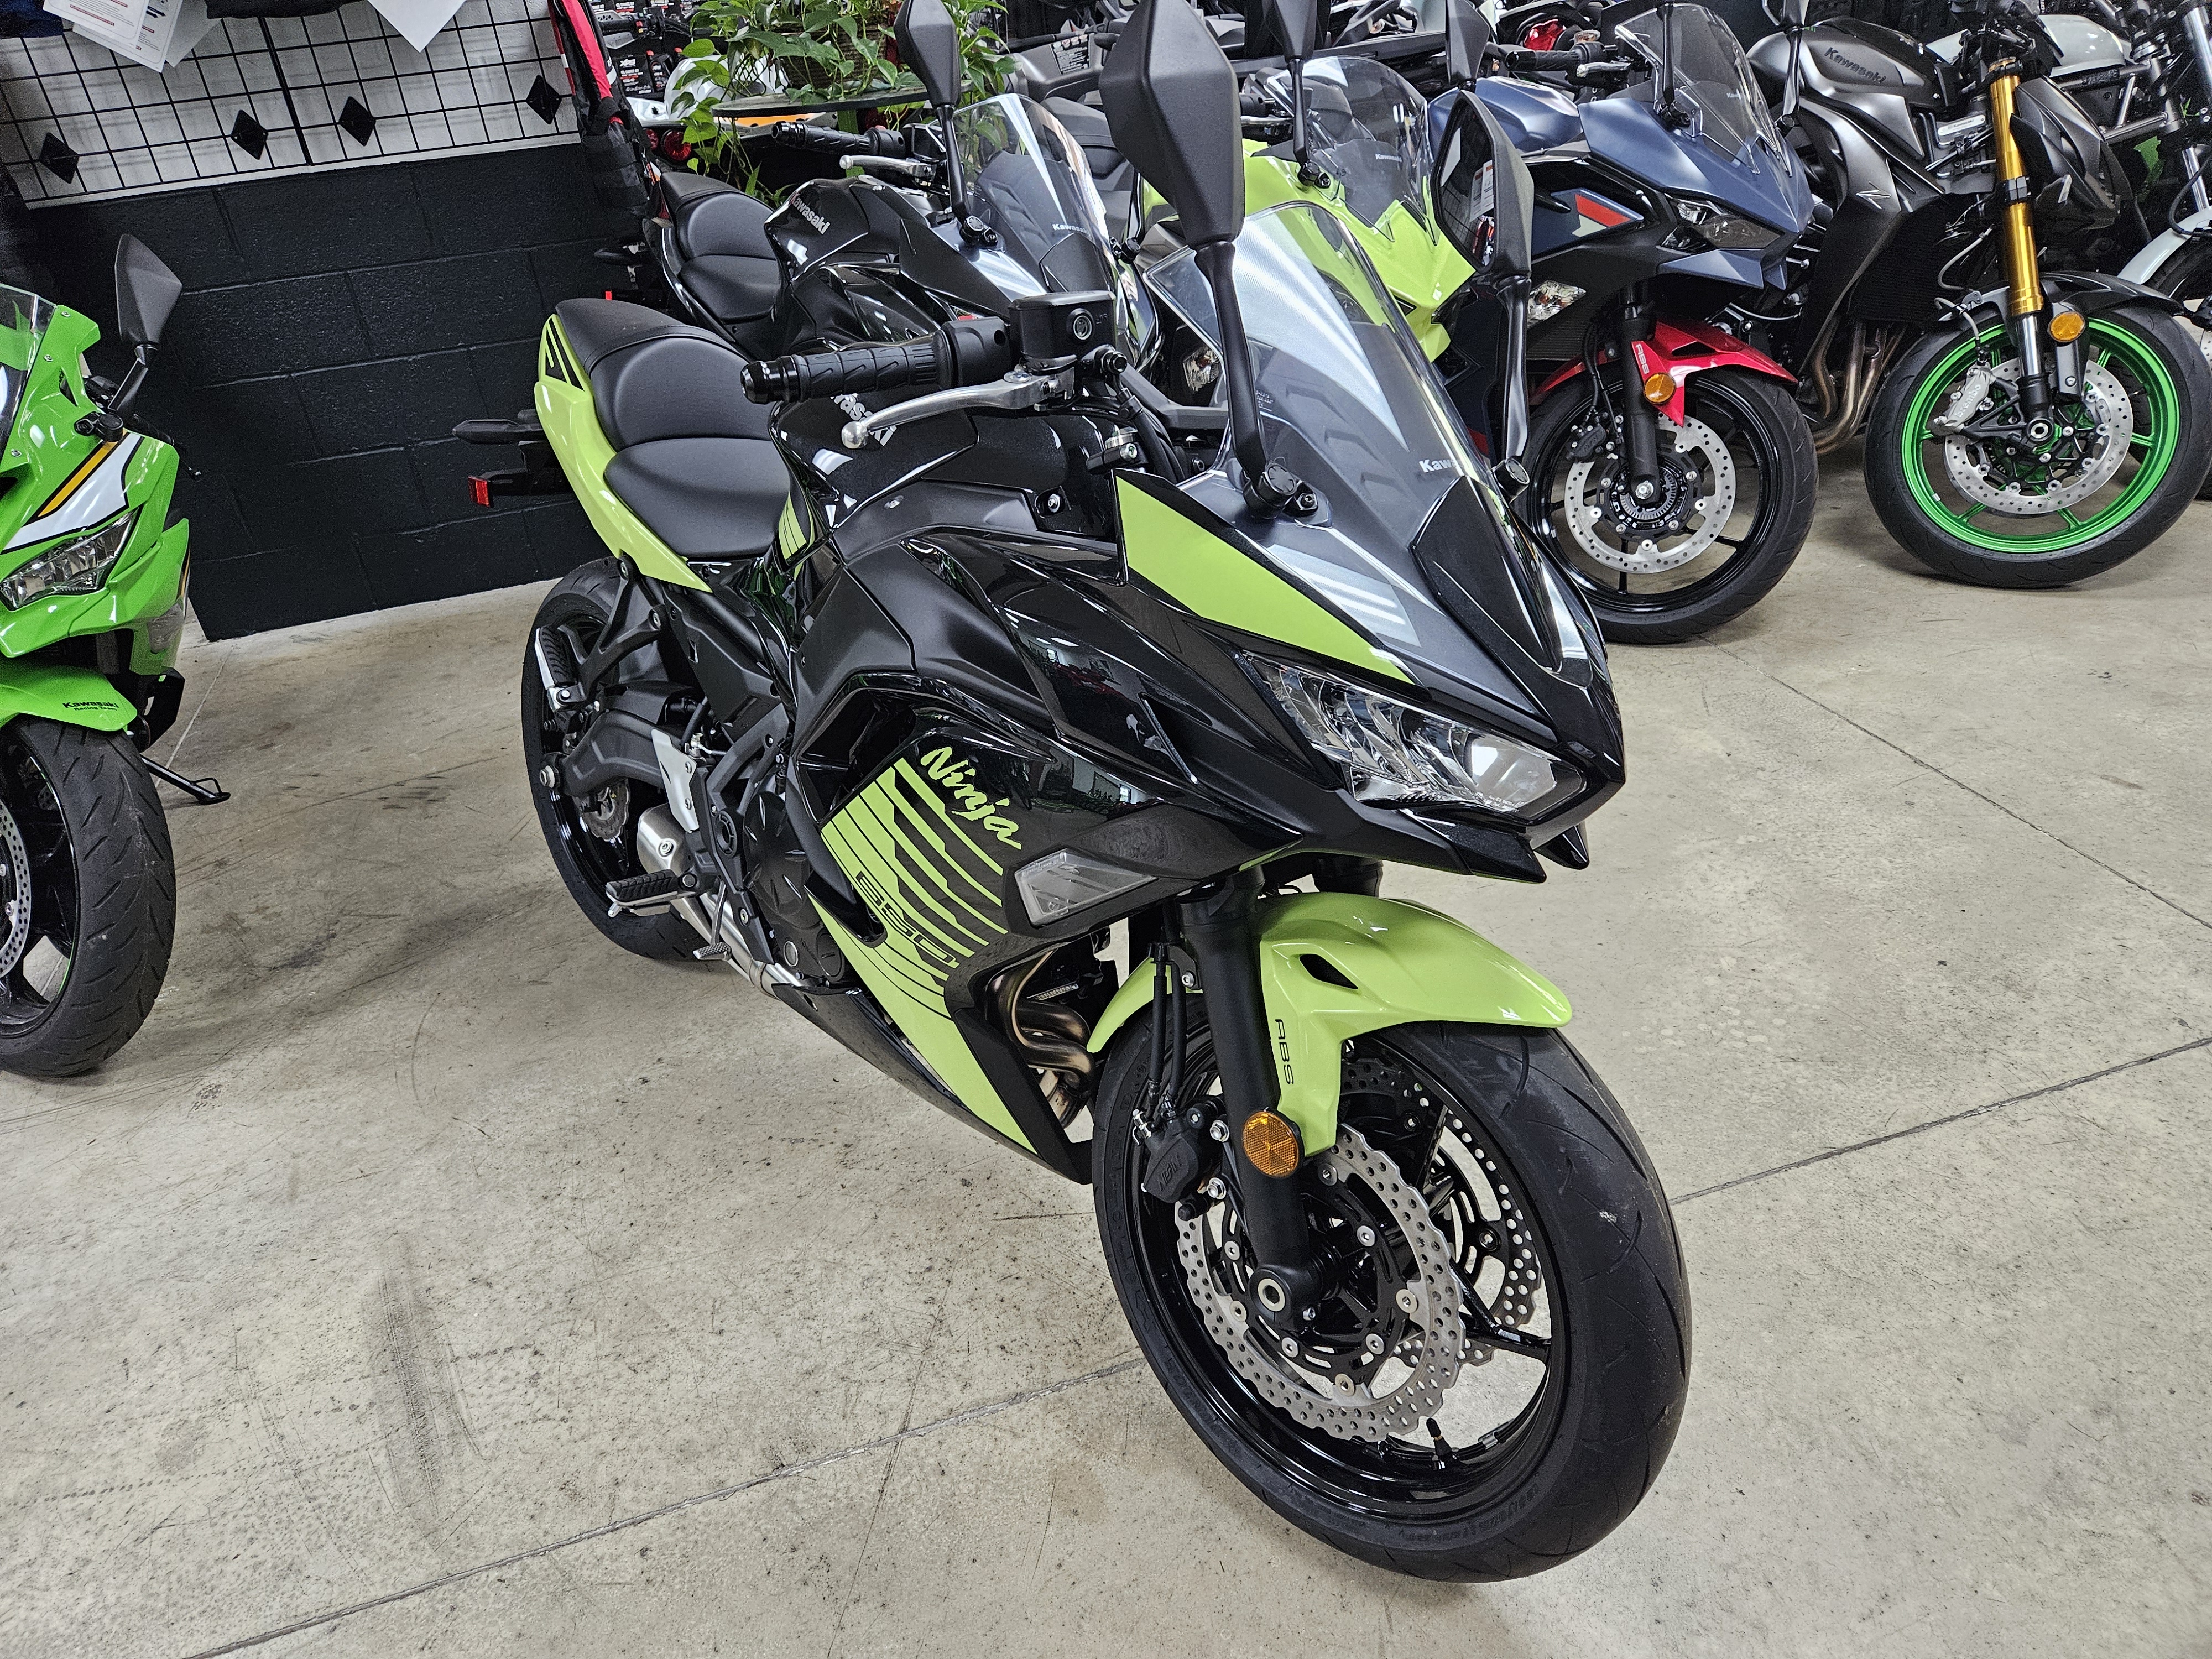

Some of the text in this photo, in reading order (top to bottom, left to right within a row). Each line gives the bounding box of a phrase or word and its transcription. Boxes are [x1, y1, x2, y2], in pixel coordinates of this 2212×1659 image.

[1824, 47, 1886, 84] Kawasaki
[790, 192, 831, 234] Kawasaki
[1052, 223, 1089, 235] Kawasak
[1635, 344, 1650, 374] ABS
[1954, 384, 1981, 418] brembo
[920, 745, 1022, 850] Ninja
[855, 871, 956, 964] 650
[1275, 1018, 1295, 1086] ABS
